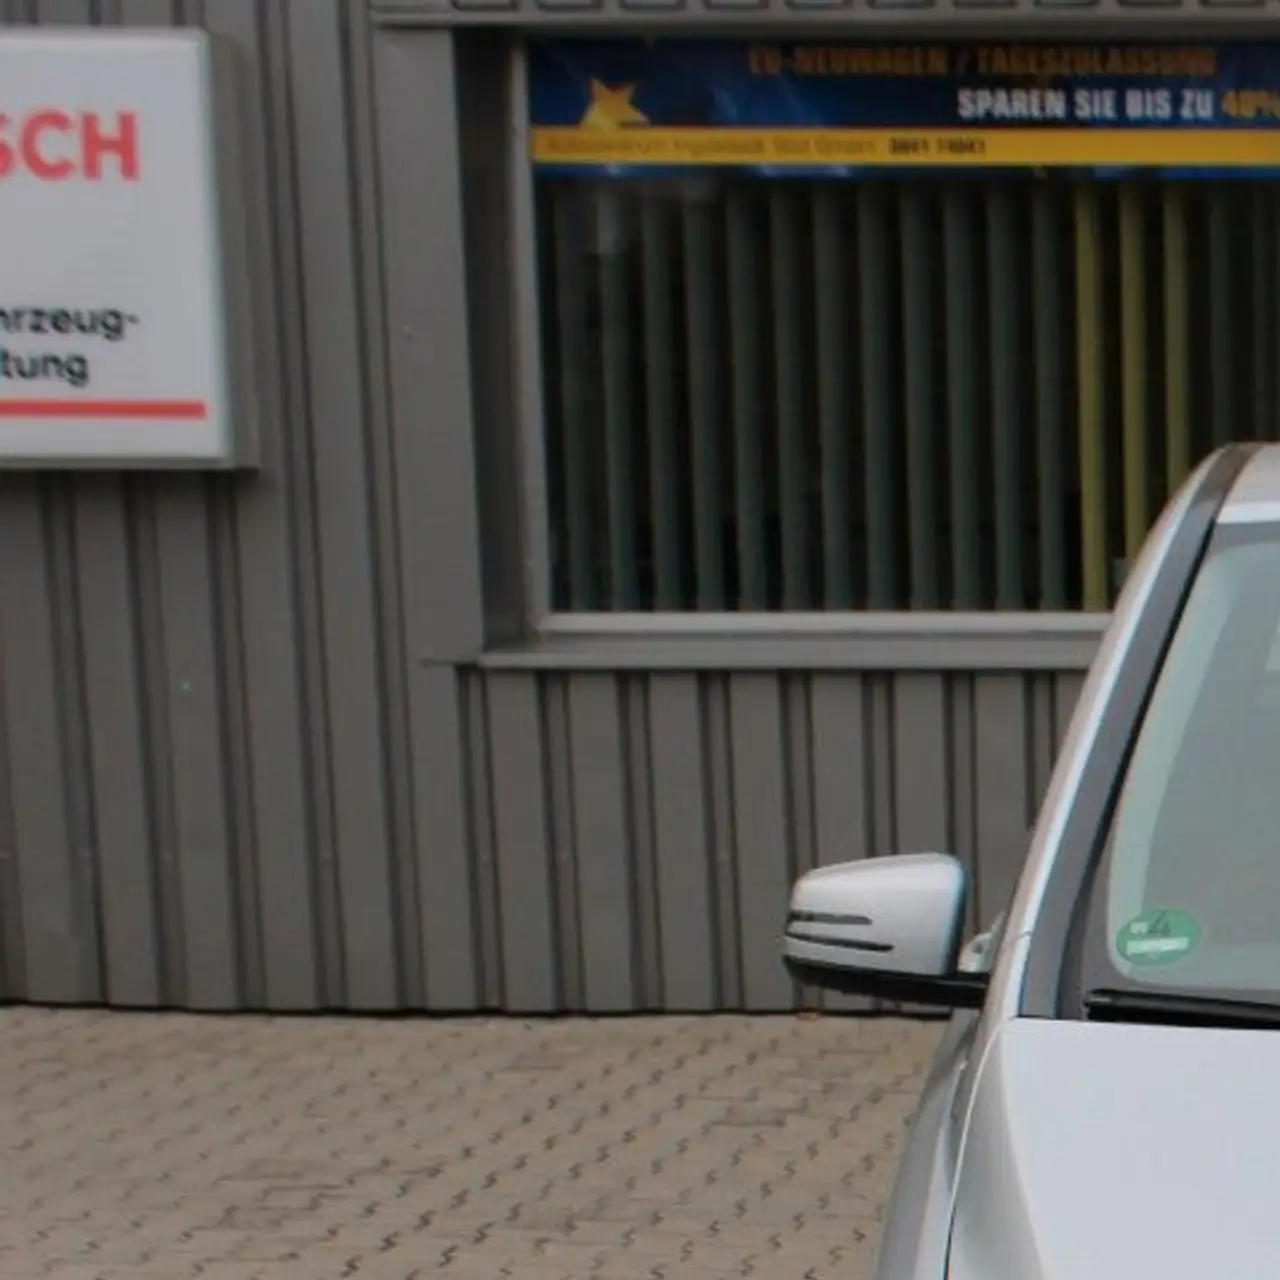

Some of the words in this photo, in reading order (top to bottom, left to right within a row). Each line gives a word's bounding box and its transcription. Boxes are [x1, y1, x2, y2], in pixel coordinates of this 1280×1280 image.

[956, 87, 1067, 120] SPAREN
[1073, 87, 1118, 120] SIE
[1125, 88, 1173, 120] BIS
[1179, 88, 1214, 120] ZU
